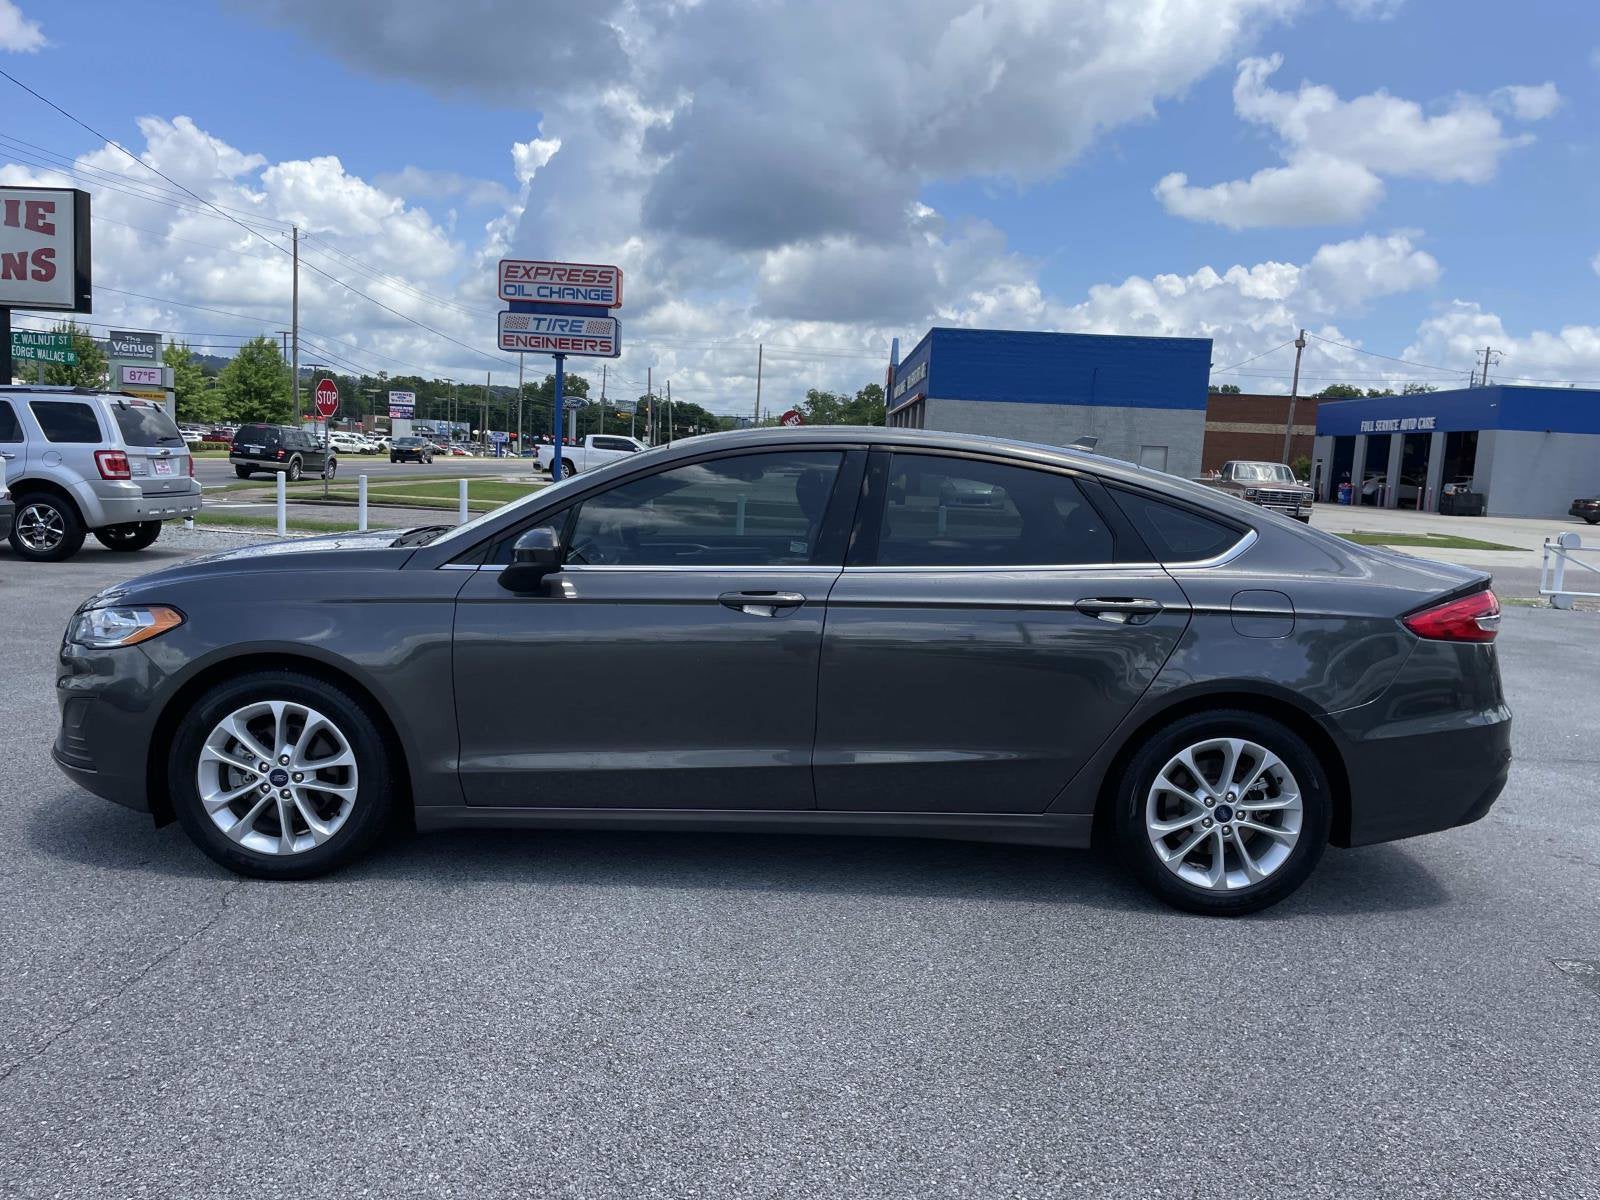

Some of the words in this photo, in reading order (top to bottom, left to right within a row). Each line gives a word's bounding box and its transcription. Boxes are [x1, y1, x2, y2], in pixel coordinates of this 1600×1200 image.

[4, 199, 56, 236] IE
[1, 248, 56, 282] NS
[504, 265, 614, 284] EXPRESS
[504, 284, 533, 297] OIL
[537, 285, 613, 302] CHANGE
[532, 316, 585, 334] TIRE
[21, 334, 56, 346] WALNUT
[58, 335, 68, 345] ST
[112, 341, 154, 354] Venue
[124, 335, 141, 344] The
[503, 334, 612, 352] ENGINEERS
[11, 345, 35, 358] EORGE
[37, 348, 66, 362] WALLACE
[67, 352, 75, 362] DR
[129, 370, 156, 382] 87°F
[317, 390, 337, 405] STOP
[1360, 420, 1375, 432] FULL
[1375, 419, 1400, 432] SERVICE
[1400, 417, 1418, 430] AUTO
[1418, 416, 1436, 430] CARE
